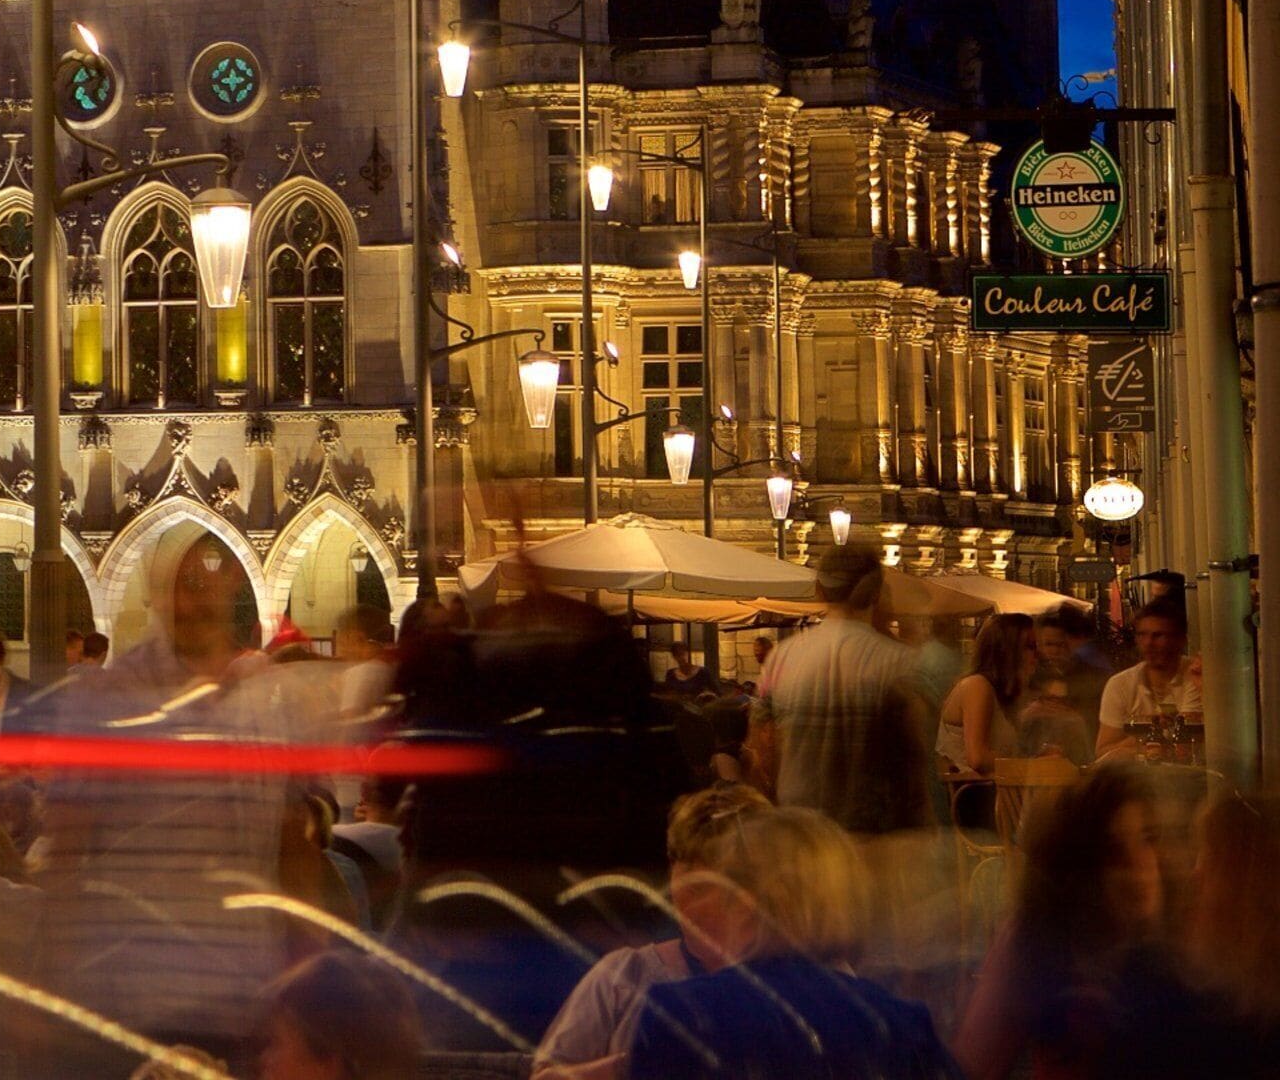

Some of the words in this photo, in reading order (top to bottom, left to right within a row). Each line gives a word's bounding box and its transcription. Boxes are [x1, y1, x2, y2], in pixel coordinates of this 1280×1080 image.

[1021, 148, 1048, 177] Bièr
[1018, 186, 1116, 205] Heineken
[1028, 221, 1054, 248] Bière
[1063, 220, 1110, 251] Heineken
[984, 286, 1087, 315] Couleur
[1092, 283, 1154, 322] Café
